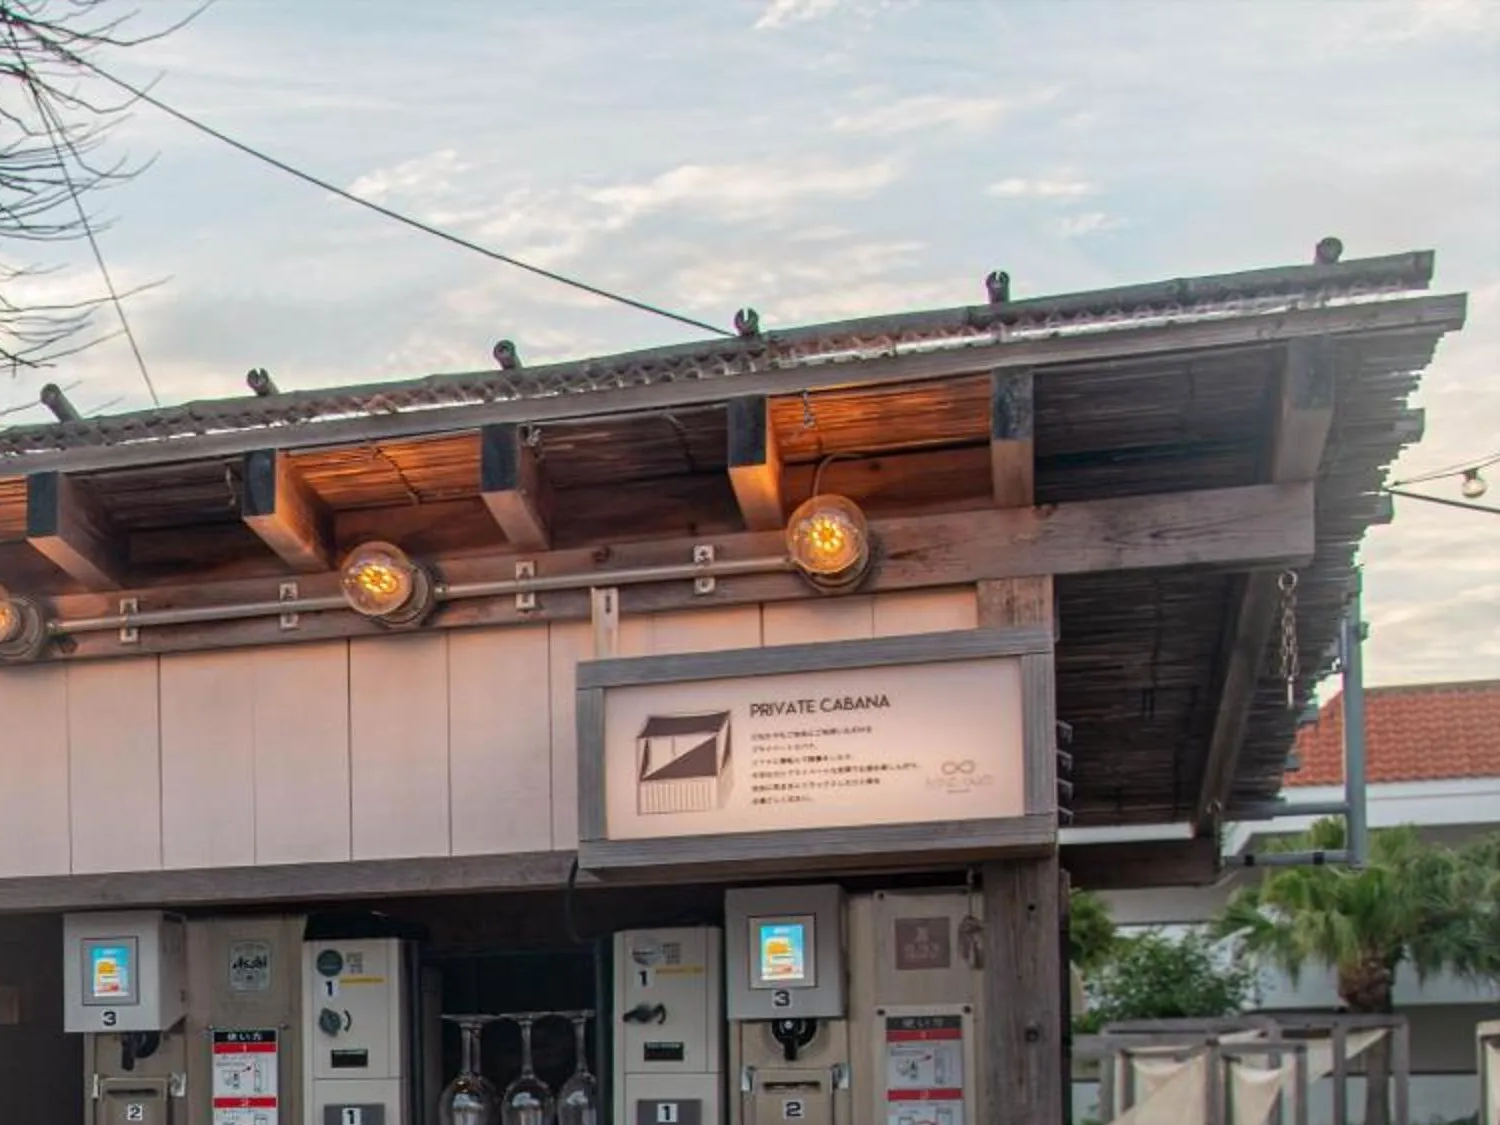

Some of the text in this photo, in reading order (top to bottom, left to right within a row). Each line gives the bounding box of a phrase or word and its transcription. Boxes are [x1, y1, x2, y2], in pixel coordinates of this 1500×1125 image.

[750, 694, 891, 717] PRIVATE CABANA
[638, 970, 647, 987] 1
[325, 980, 333, 997] 1
[774, 990, 790, 1007] 3
[103, 1011, 117, 1027] 3
[129, 1104, 141, 1119] 2
[347, 1109, 355, 1125] 1
[663, 1105, 671, 1121] 1
[786, 1101, 801, 1117] 2
